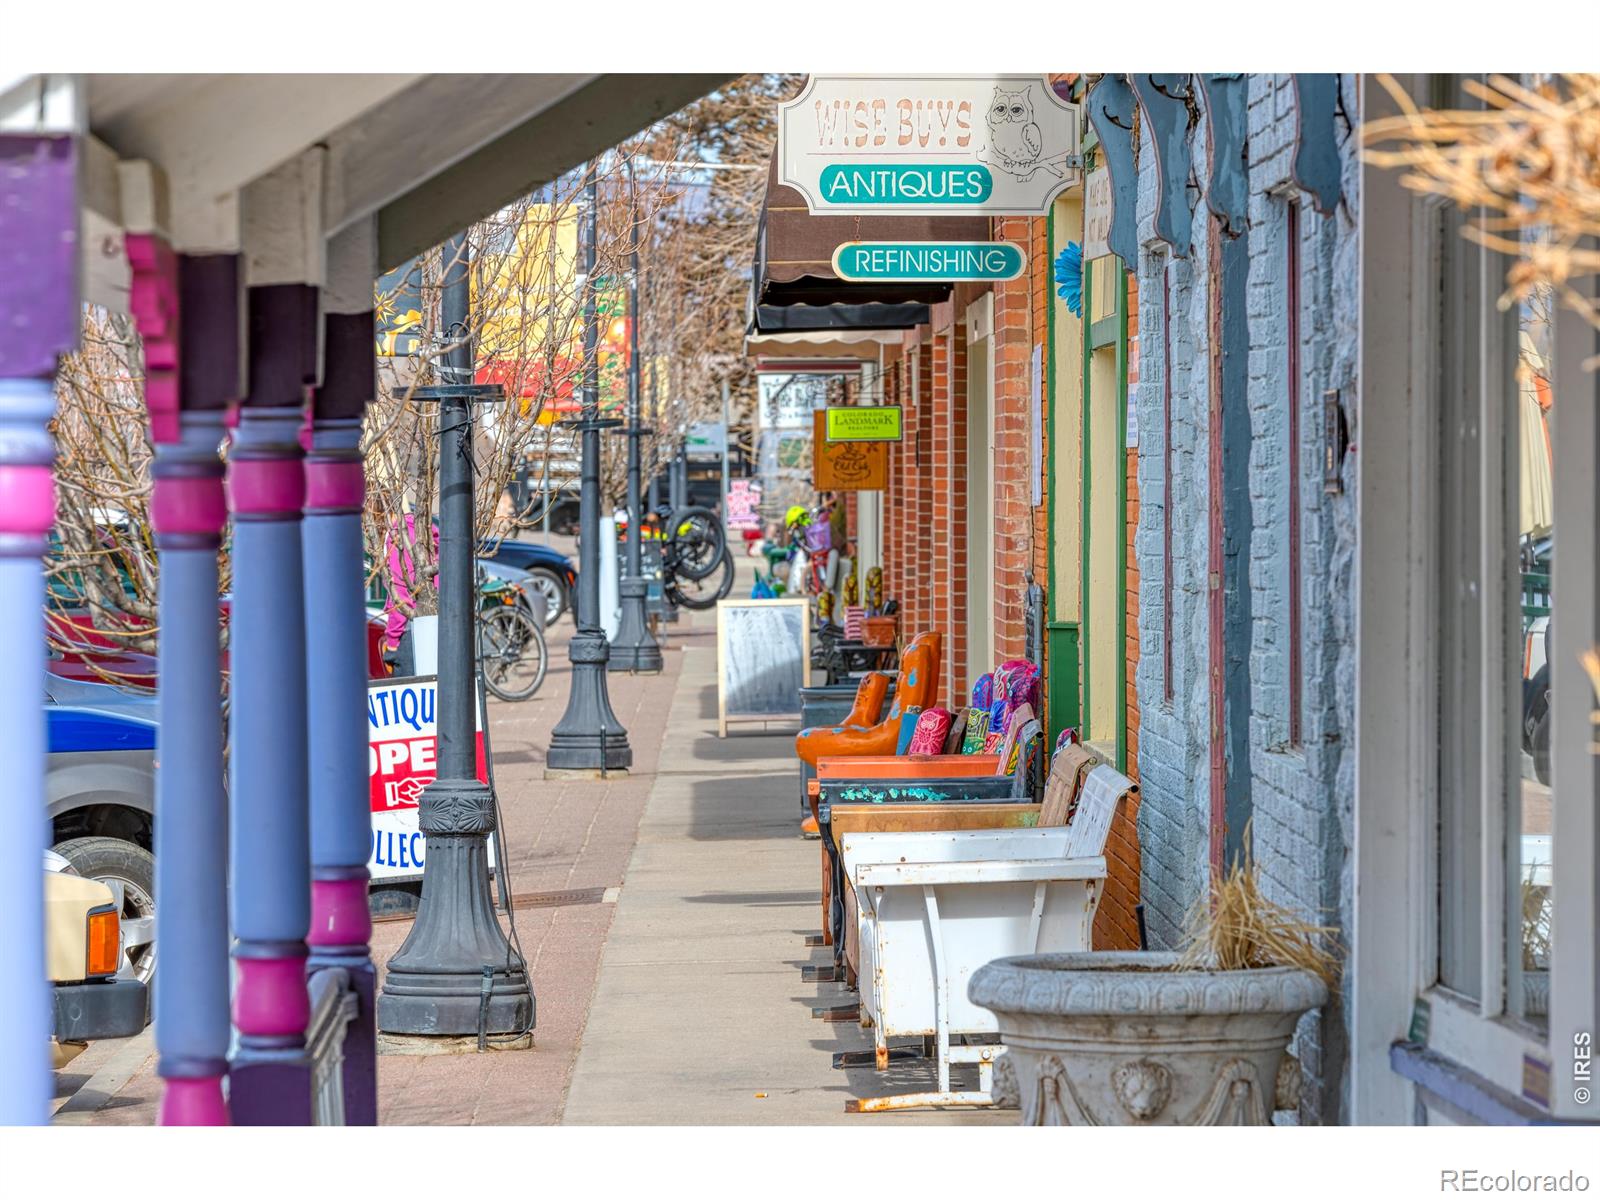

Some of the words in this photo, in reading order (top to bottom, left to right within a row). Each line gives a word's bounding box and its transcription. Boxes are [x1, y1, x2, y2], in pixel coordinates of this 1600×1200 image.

[815, 99, 886, 147] WISE
[896, 99, 972, 148] BUYS
[829, 170, 984, 198] ANTIQUES
[855, 249, 1007, 272] REFINISHING
[834, 414, 893, 426] LANDMARK
